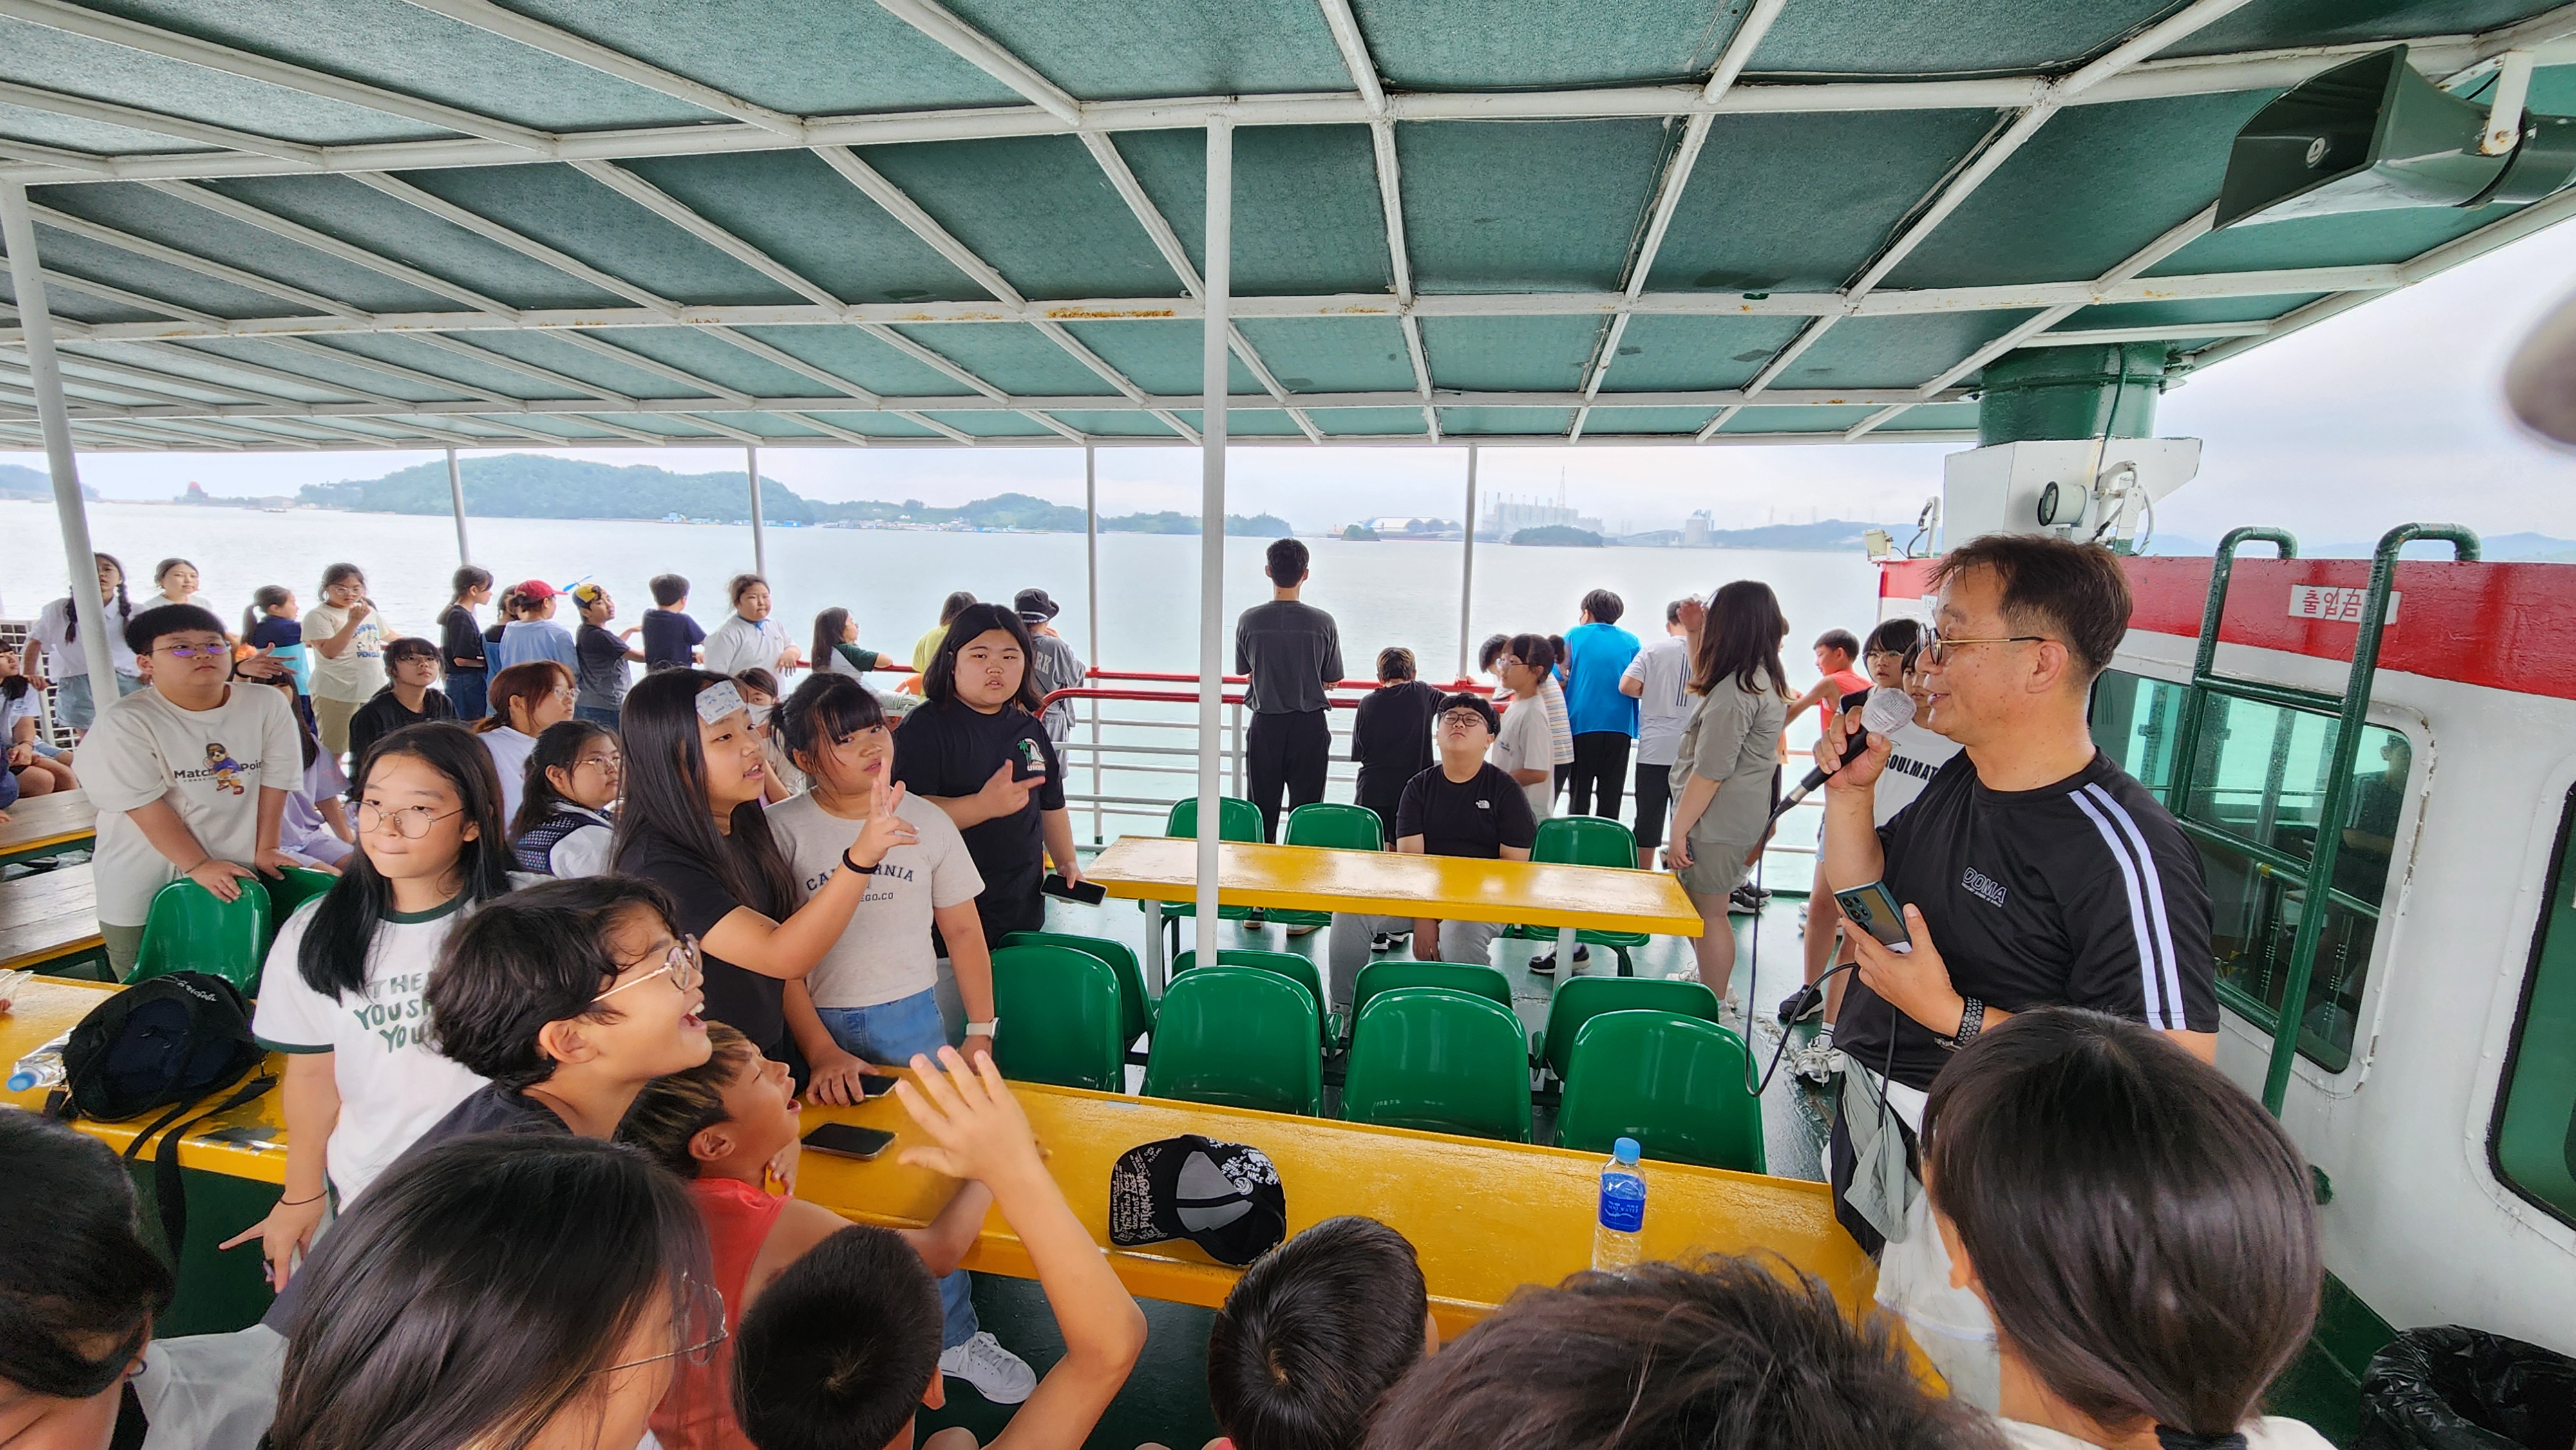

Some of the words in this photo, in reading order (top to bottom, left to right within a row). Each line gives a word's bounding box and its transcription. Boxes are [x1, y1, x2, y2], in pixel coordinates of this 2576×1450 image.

[2303, 590, 2362, 617] 출입금
[1034, 651, 1052, 675] RK
[240, 760, 261, 772] Poi
[1885, 753, 1939, 782] OULMAT
[806, 864, 914, 891] CARNIA
[1963, 867, 2007, 904] DOMA
[860, 892, 894, 902] EGO.CO
[353, 1003, 402, 1030] YOU
[379, 1024, 428, 1053] YOU
[1247, 1171, 1264, 1183] NICE
[1123, 1193, 1132, 1214] bitch
[1132, 1195, 1140, 1212] not
